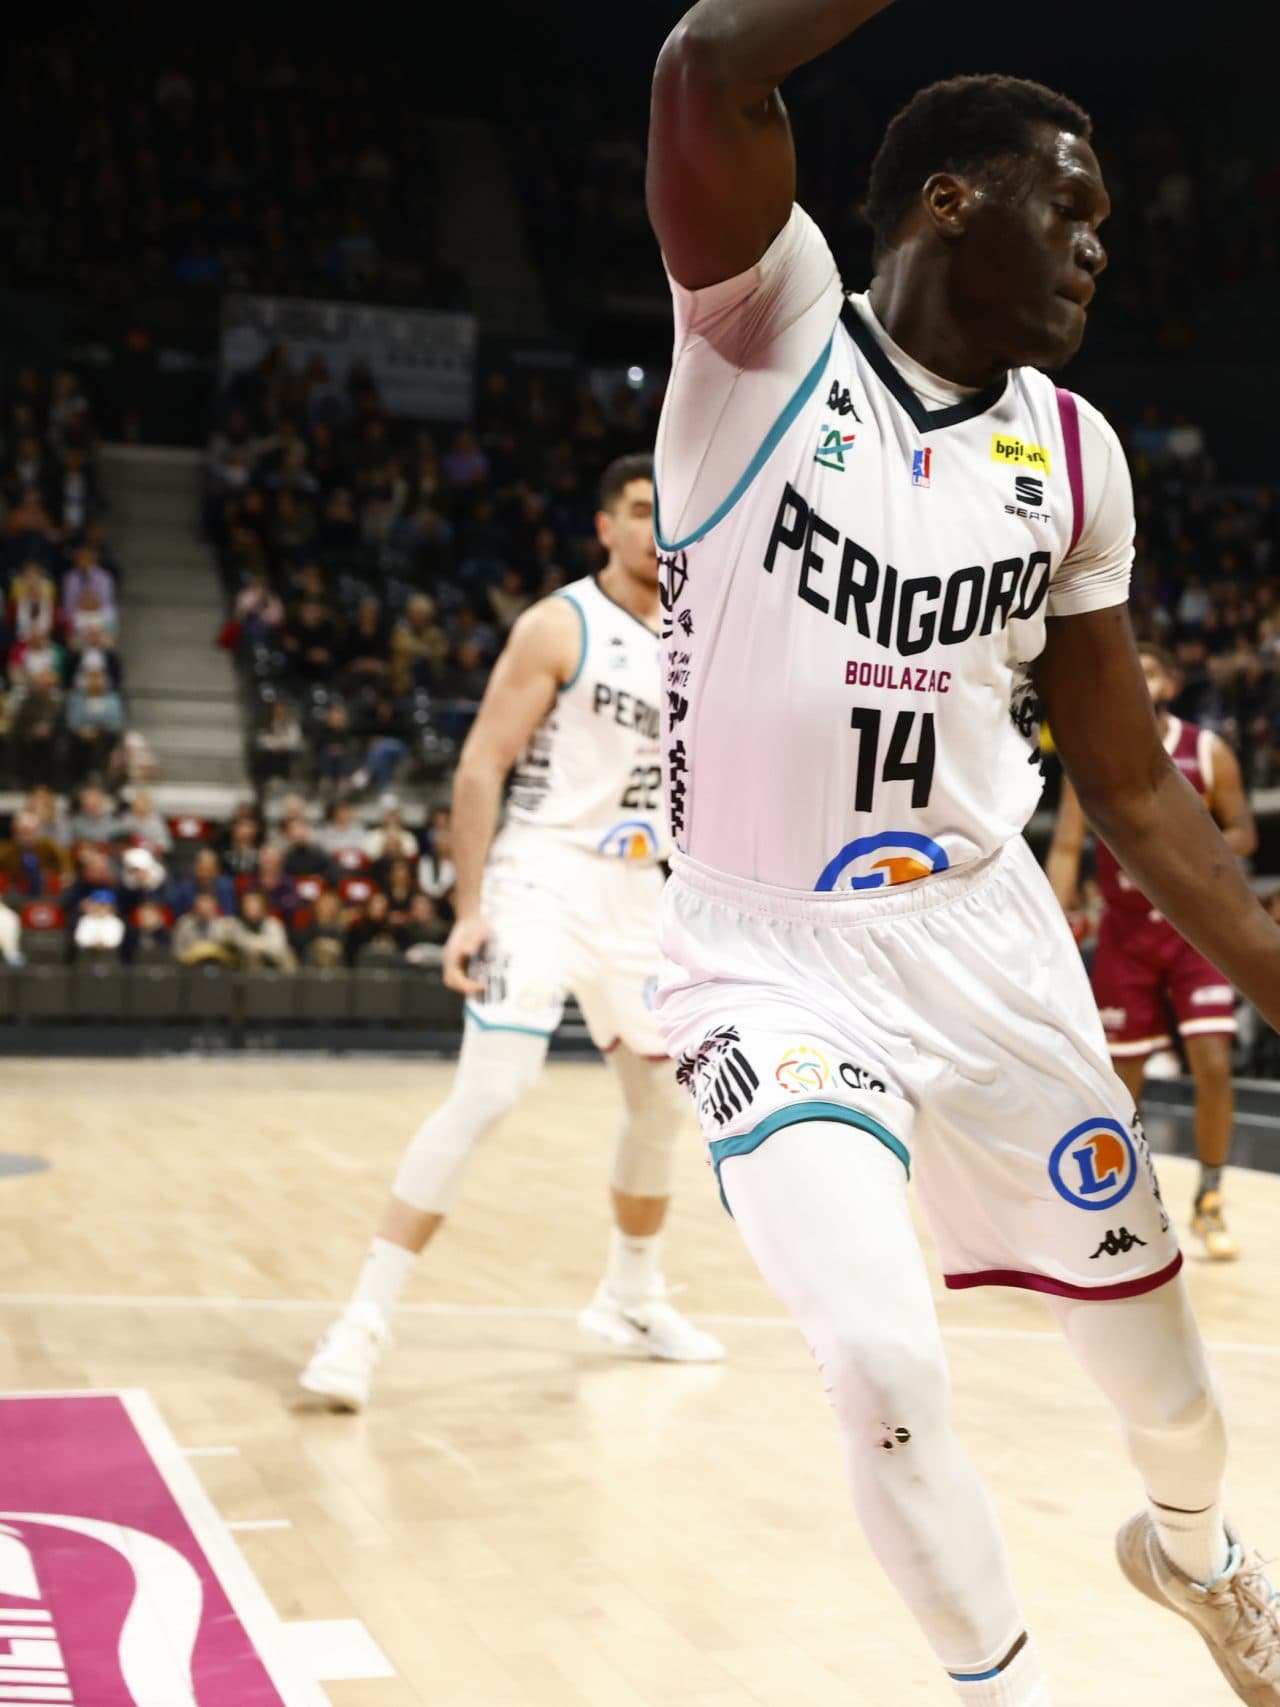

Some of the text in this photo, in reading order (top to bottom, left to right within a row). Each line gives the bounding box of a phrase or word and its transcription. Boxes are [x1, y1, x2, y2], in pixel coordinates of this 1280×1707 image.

[1004, 505, 1051, 523] SEAT
[763, 480, 1051, 656] PERIGORD
[845, 661, 952, 693] BOULAZAC
[851, 707, 936, 813] 14
